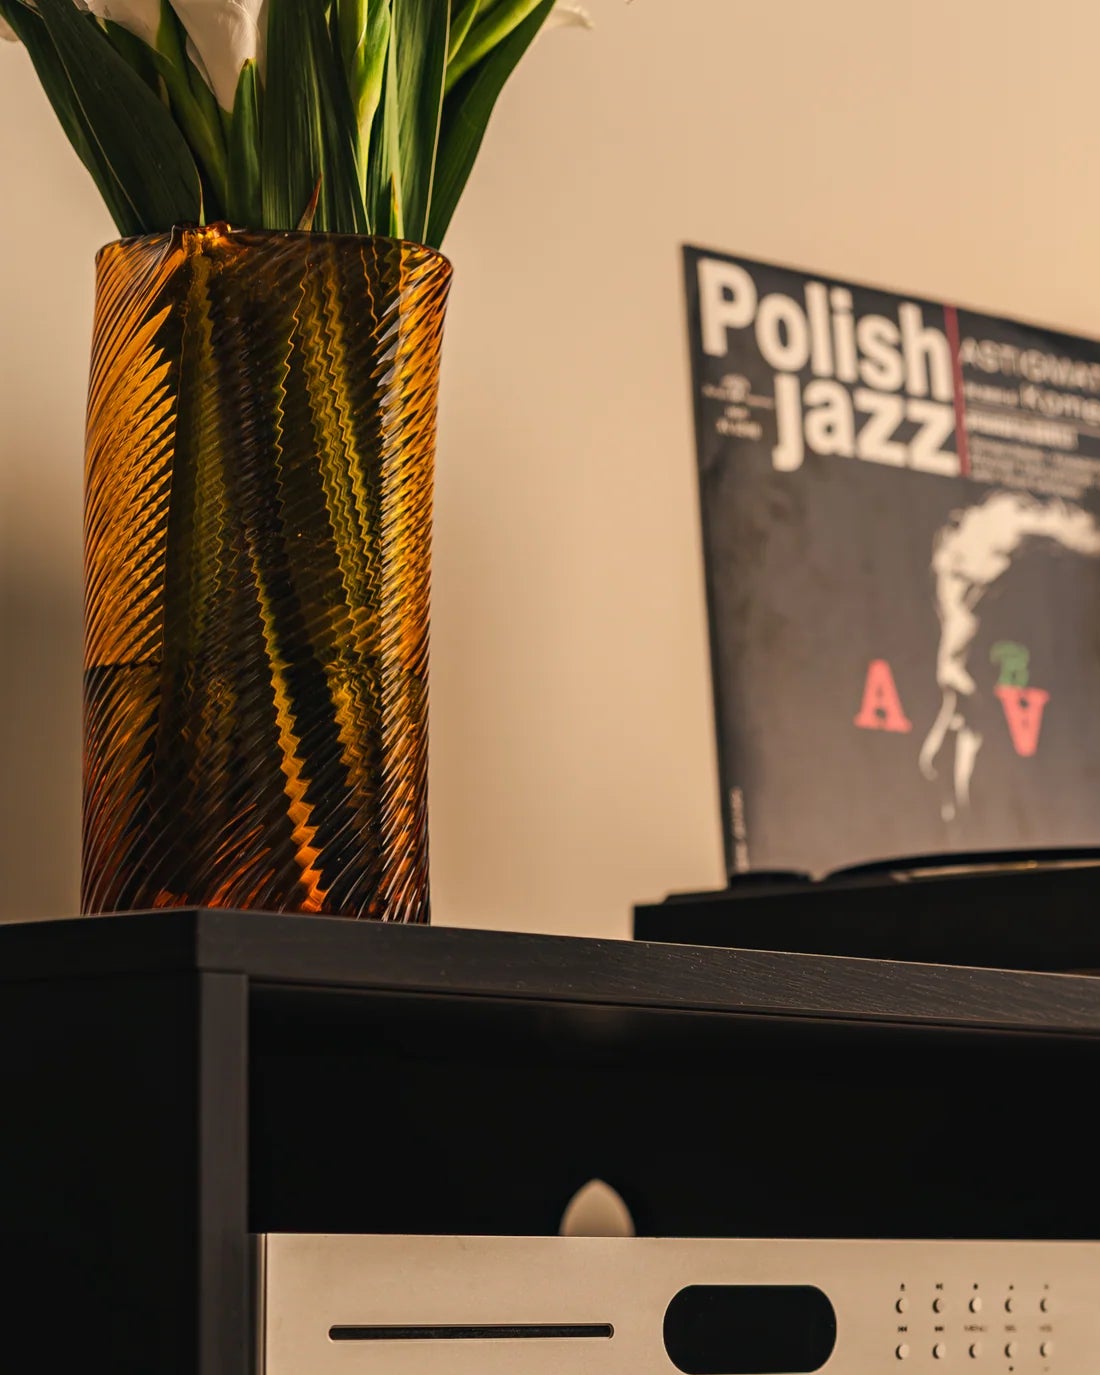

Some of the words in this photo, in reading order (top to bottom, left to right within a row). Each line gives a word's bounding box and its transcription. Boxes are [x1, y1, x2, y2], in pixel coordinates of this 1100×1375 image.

[698, 258, 952, 400] Polish
[772, 373, 961, 474] jazz
[853, 659, 912, 733] A
